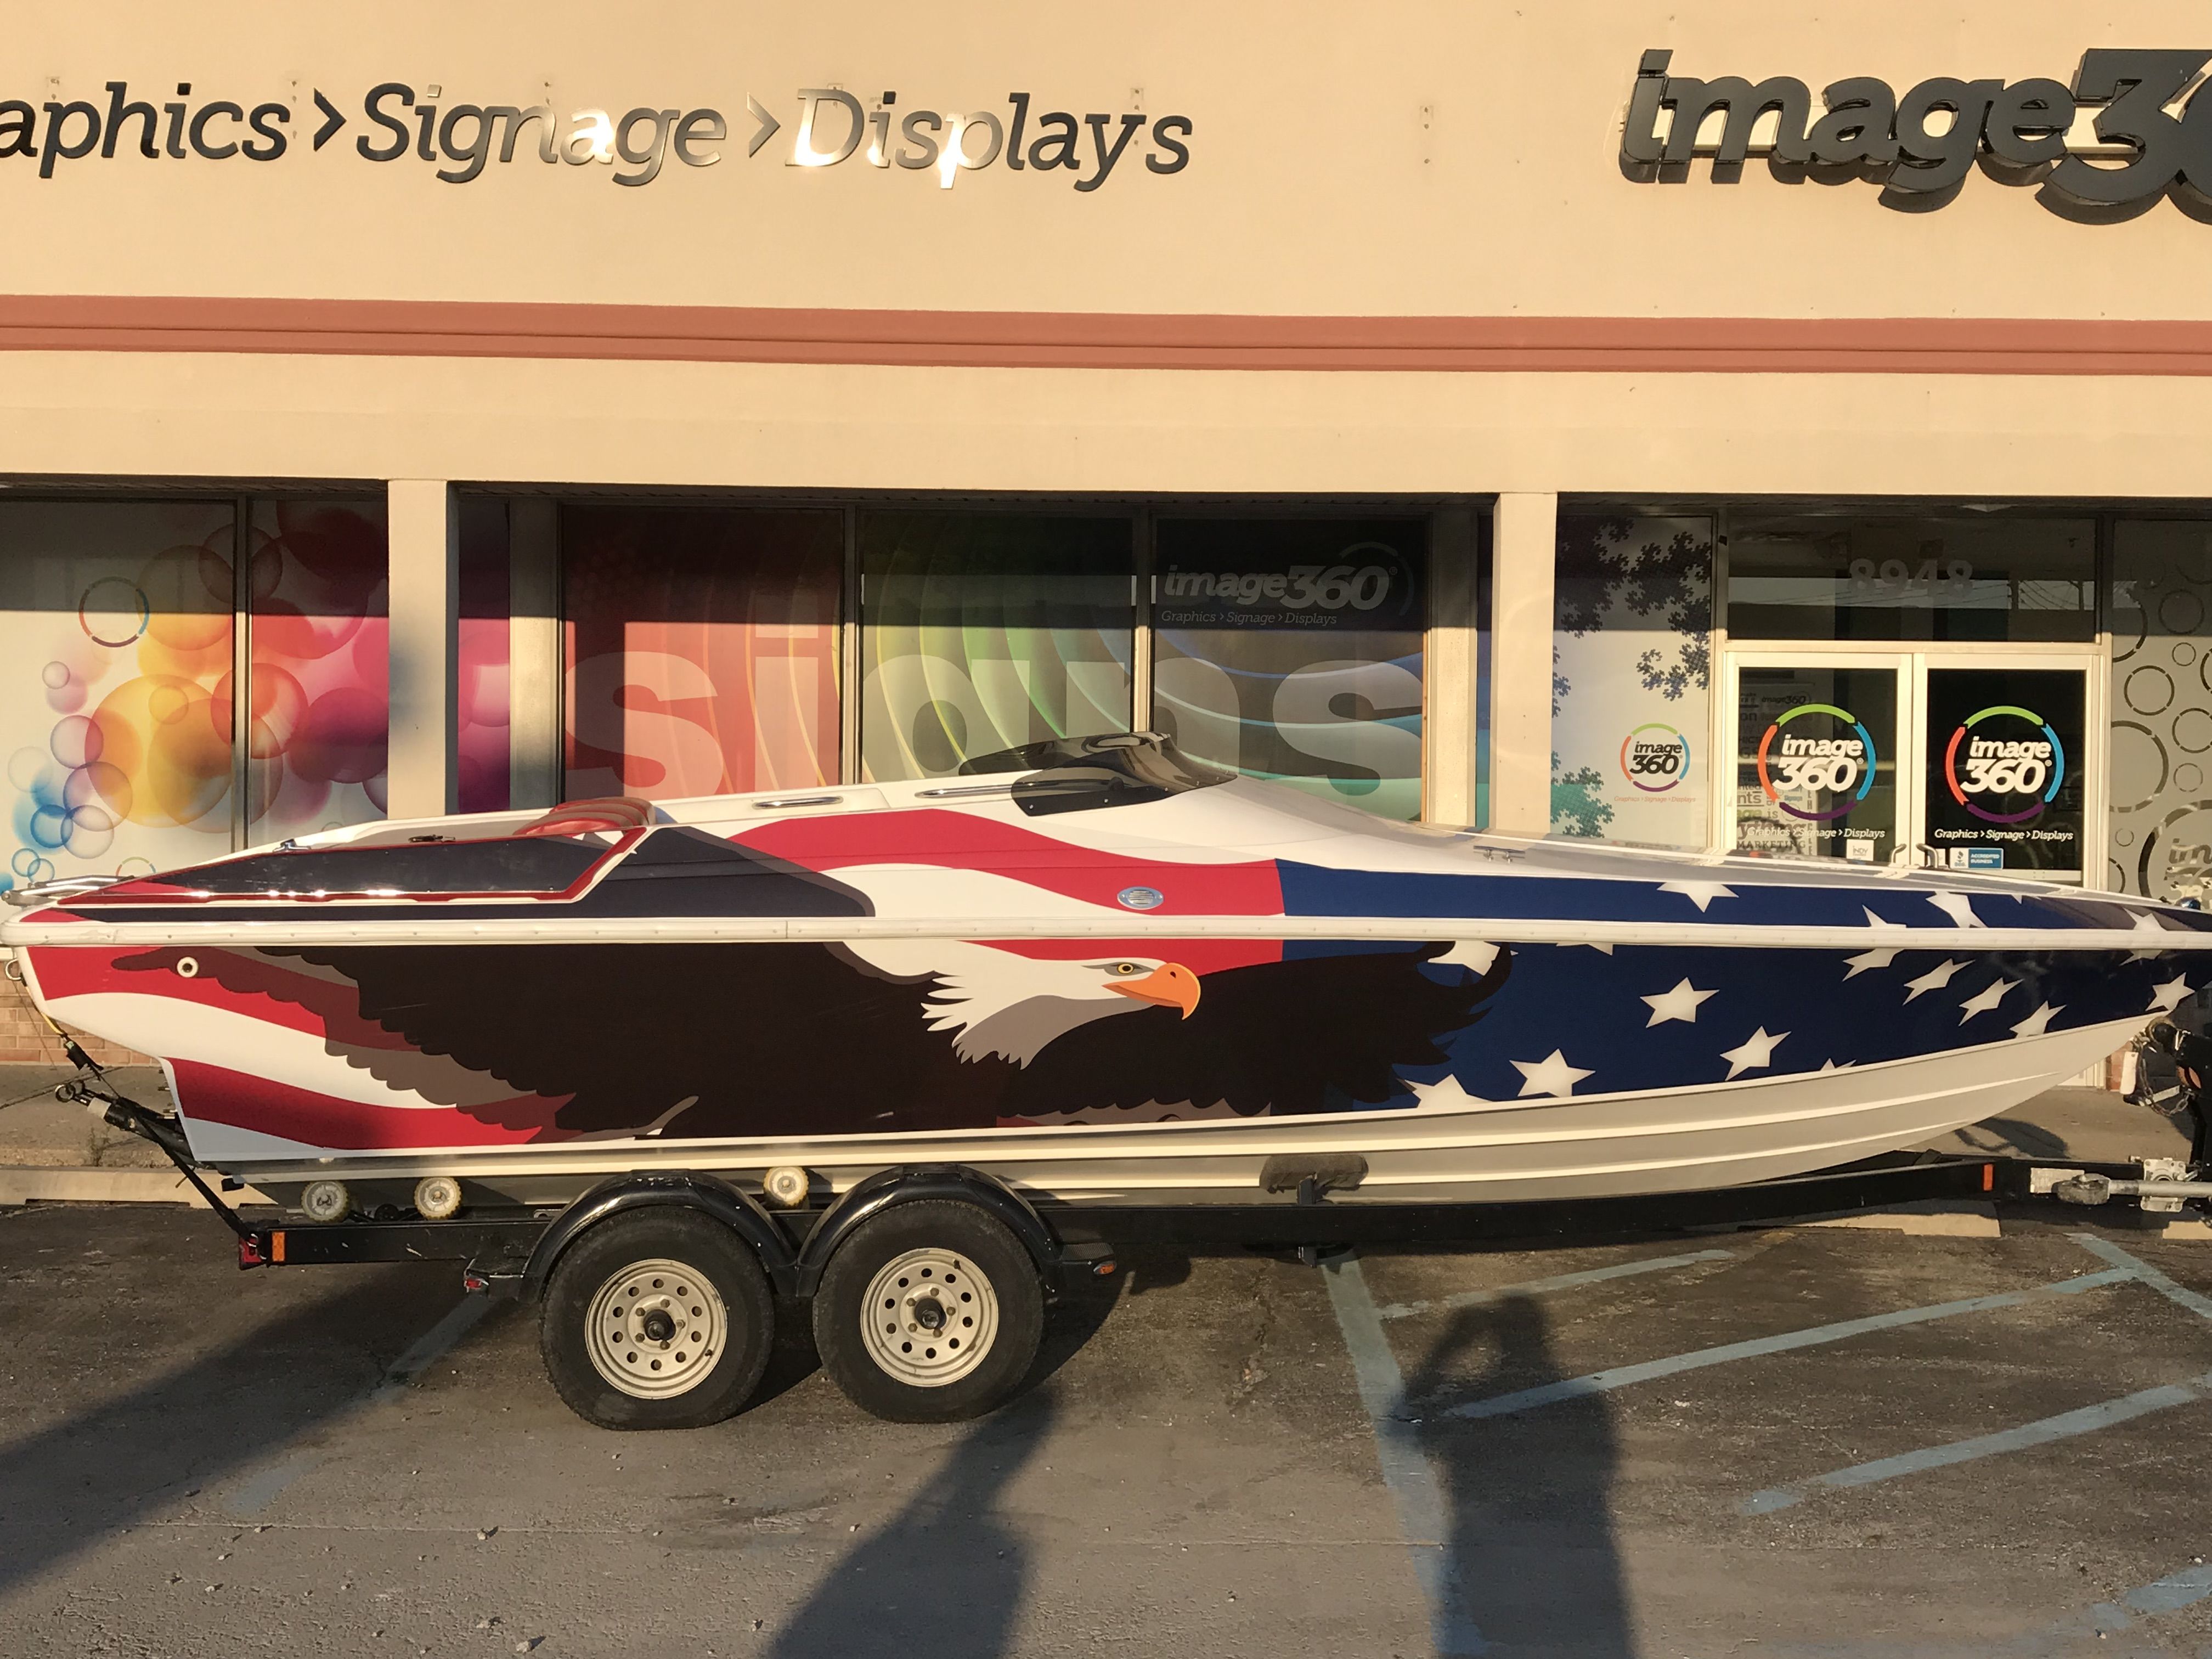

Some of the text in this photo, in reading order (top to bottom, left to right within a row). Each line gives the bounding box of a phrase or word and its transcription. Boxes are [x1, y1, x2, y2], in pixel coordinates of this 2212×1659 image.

[0, 82, 1193, 191] aphics Signage Displays
[1164, 565, 1390, 610] image360
[1847, 558, 1973, 598] 8948
[1161, 611, 1337, 627] Graphics Signage Displays
[1634, 741, 1683, 755] image
[1782, 734, 1863, 757] image
[1970, 736, 2052, 761] image
[1629, 754, 1679, 774] 360
[1772, 757, 1858, 792] 360
[1960, 759, 2046, 793] 360
[1747, 827, 1886, 839] Graphics Signage Displays
[1934, 829, 2074, 842] Graphics Signage Displays
